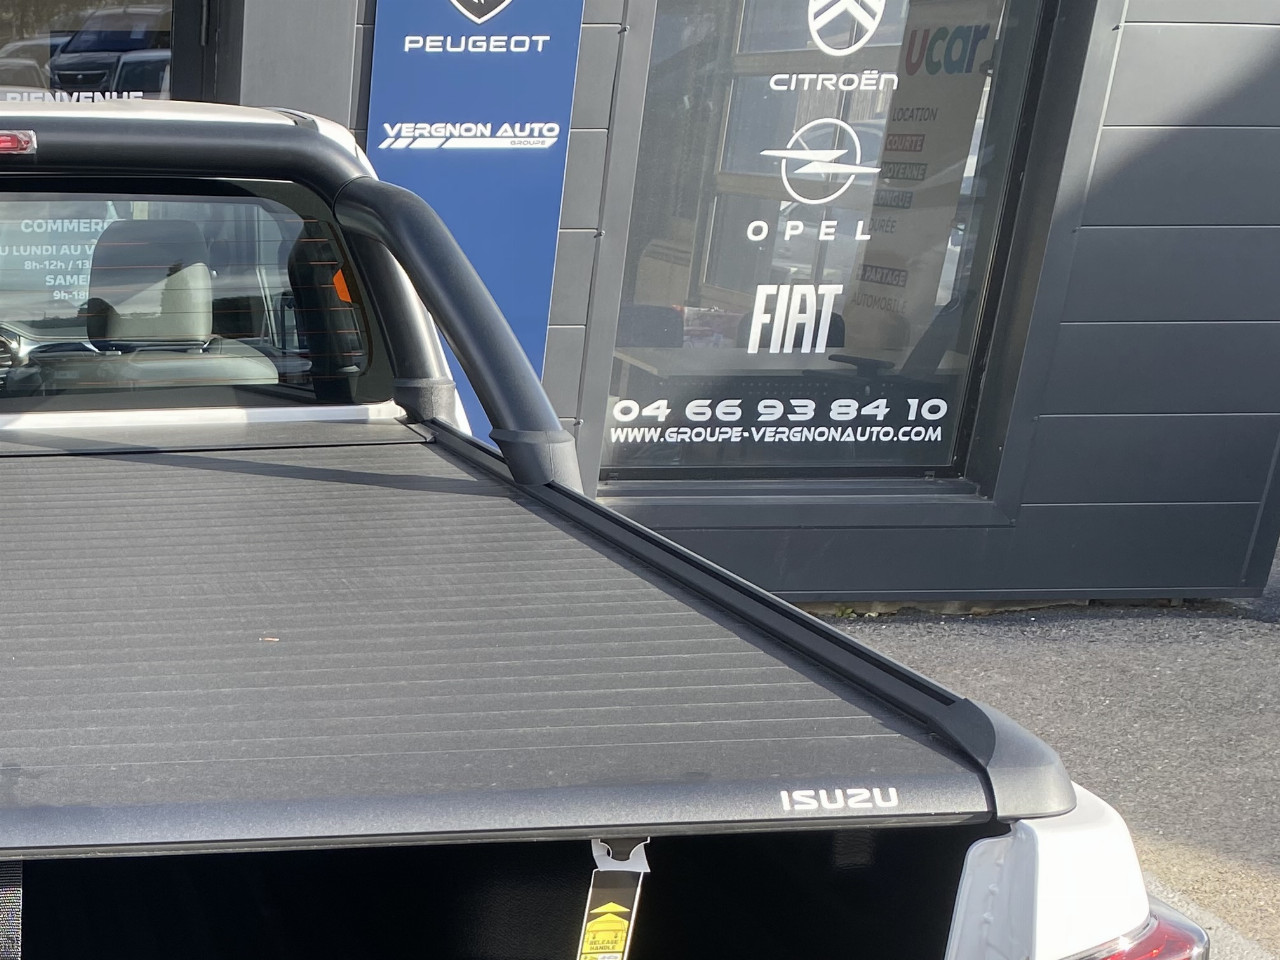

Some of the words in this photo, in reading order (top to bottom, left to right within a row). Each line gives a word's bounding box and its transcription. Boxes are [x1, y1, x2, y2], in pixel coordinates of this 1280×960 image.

[404, 35, 551, 52] PEUGEOT
[905, 24, 990, 76] ucar
[769, 70, 899, 91] CITROËN
[892, 107, 939, 122] LOCATION
[383, 122, 492, 137] VERGNON
[495, 122, 561, 137] AUTO
[886, 135, 924, 151] COURTE
[747, 220, 871, 241] OPEL
[12, 245, 58, 256] LUNDI
[60, 245, 80, 255] AU
[24, 260, 66, 270] 8h-12h
[864, 266, 907, 286] PARTAGE
[747, 284, 844, 354] FIAT
[612, 399, 672, 422] 04
[685, 399, 744, 421] 66
[757, 398, 816, 421] 93
[829, 398, 891, 421] 84
[907, 398, 949, 420] 10
[610, 426, 943, 443] WWW.GROUPE-VERGNONAUTO.COM
[780, 787, 899, 811] ISUZU
